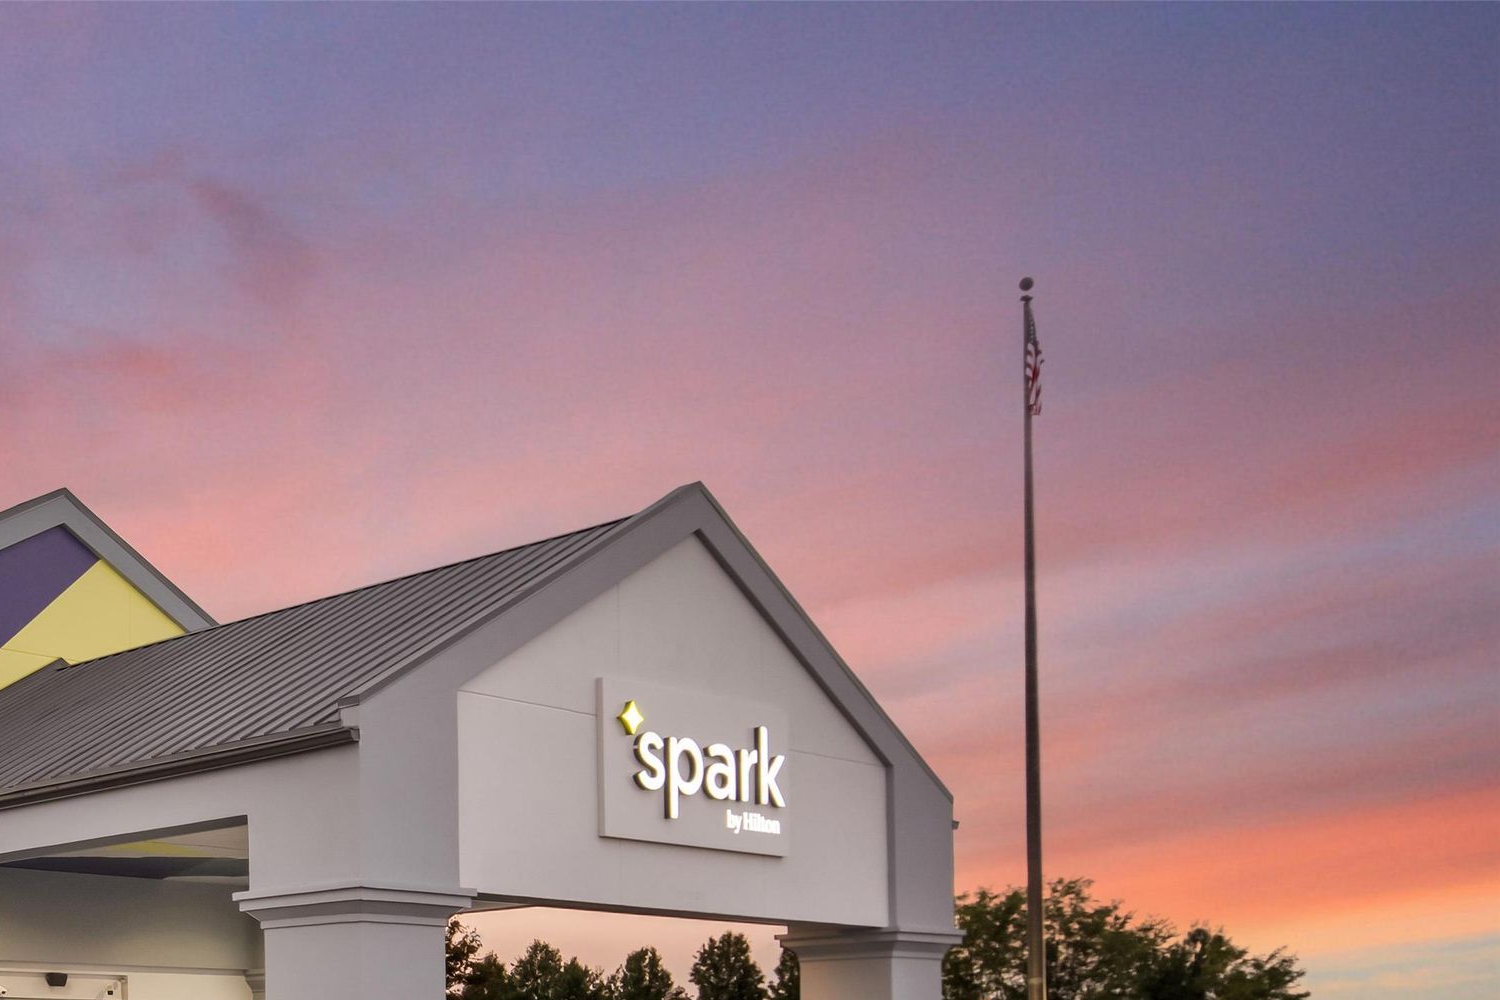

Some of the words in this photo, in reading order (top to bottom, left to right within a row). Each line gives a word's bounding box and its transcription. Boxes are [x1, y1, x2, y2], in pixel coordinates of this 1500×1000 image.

[633, 726, 786, 819] spark
[726, 809, 741, 834] by
[742, 811, 781, 834] Hilton
